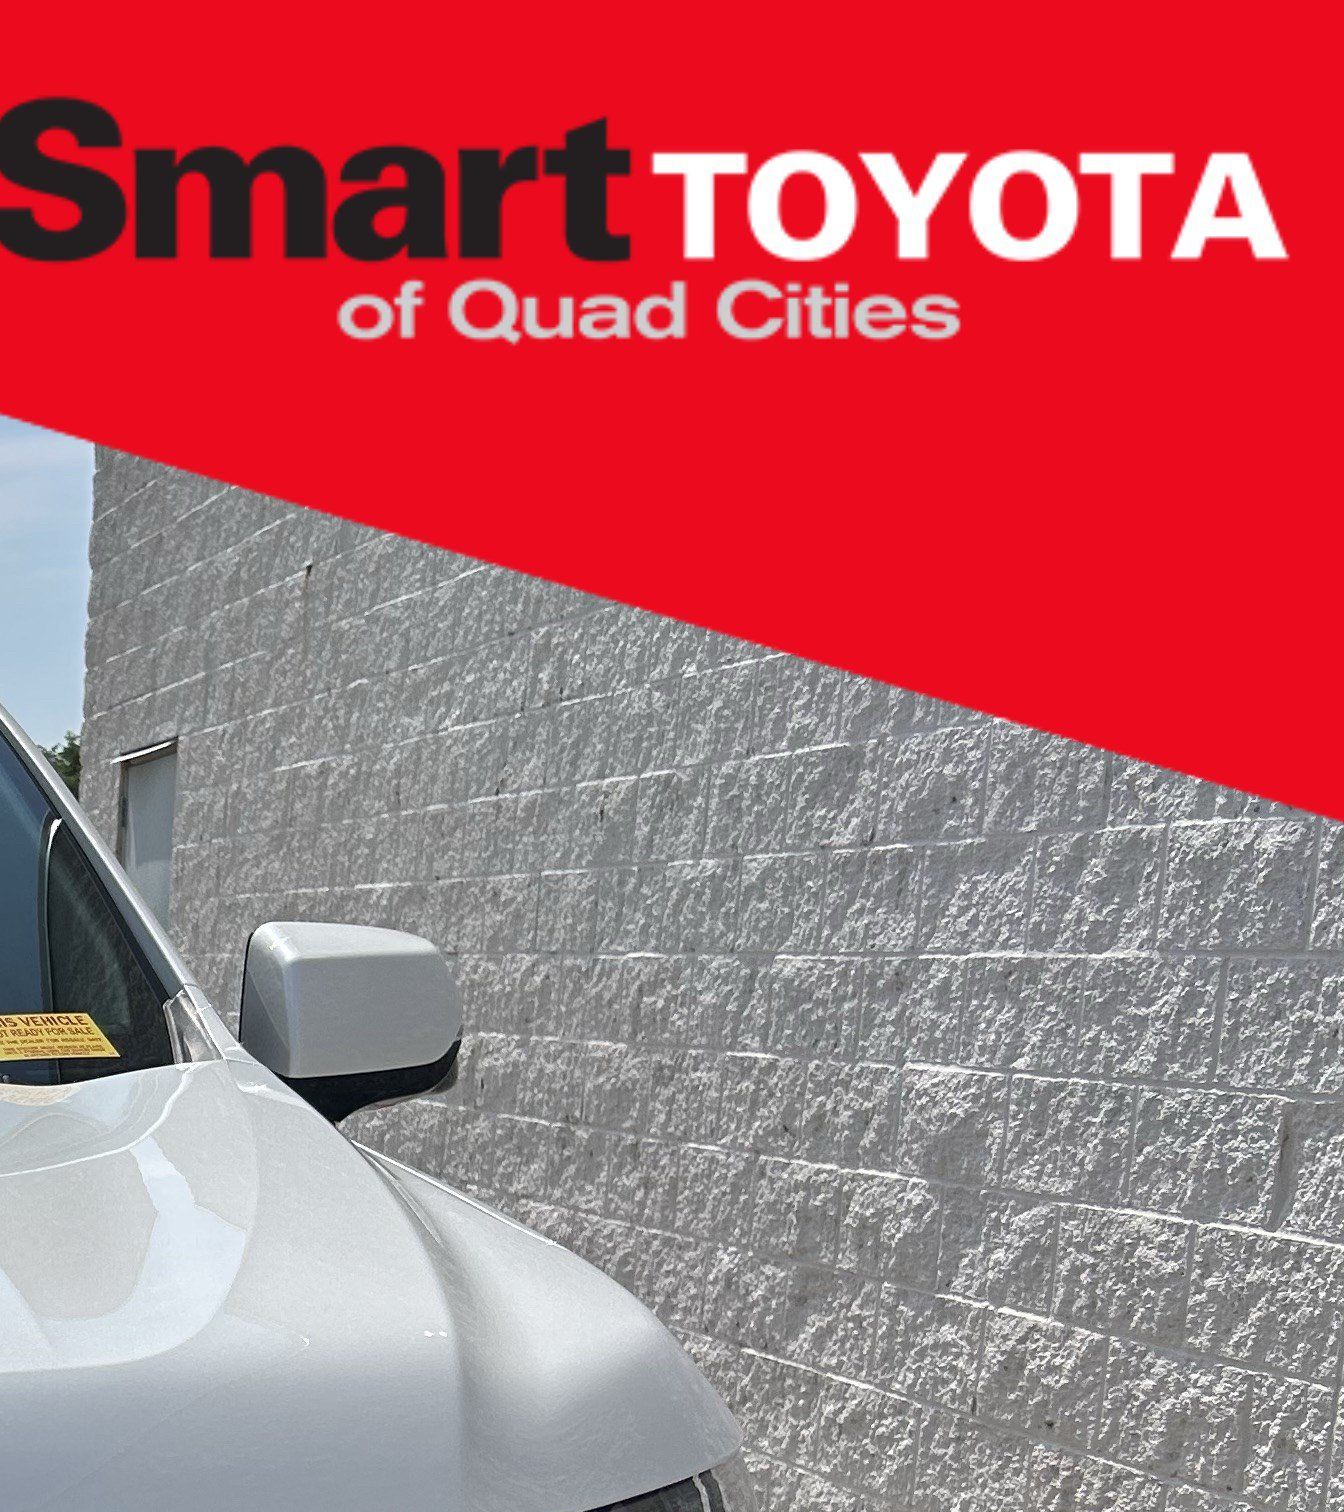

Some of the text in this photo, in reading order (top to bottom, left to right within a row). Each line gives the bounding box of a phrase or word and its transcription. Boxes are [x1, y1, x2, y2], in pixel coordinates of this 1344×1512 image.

[19, 1015, 89, 1027] VEHICLE
[11, 1028, 45, 1037] READY
[46, 1027, 65, 1036] FOR
[68, 1026, 96, 1036] SALE
